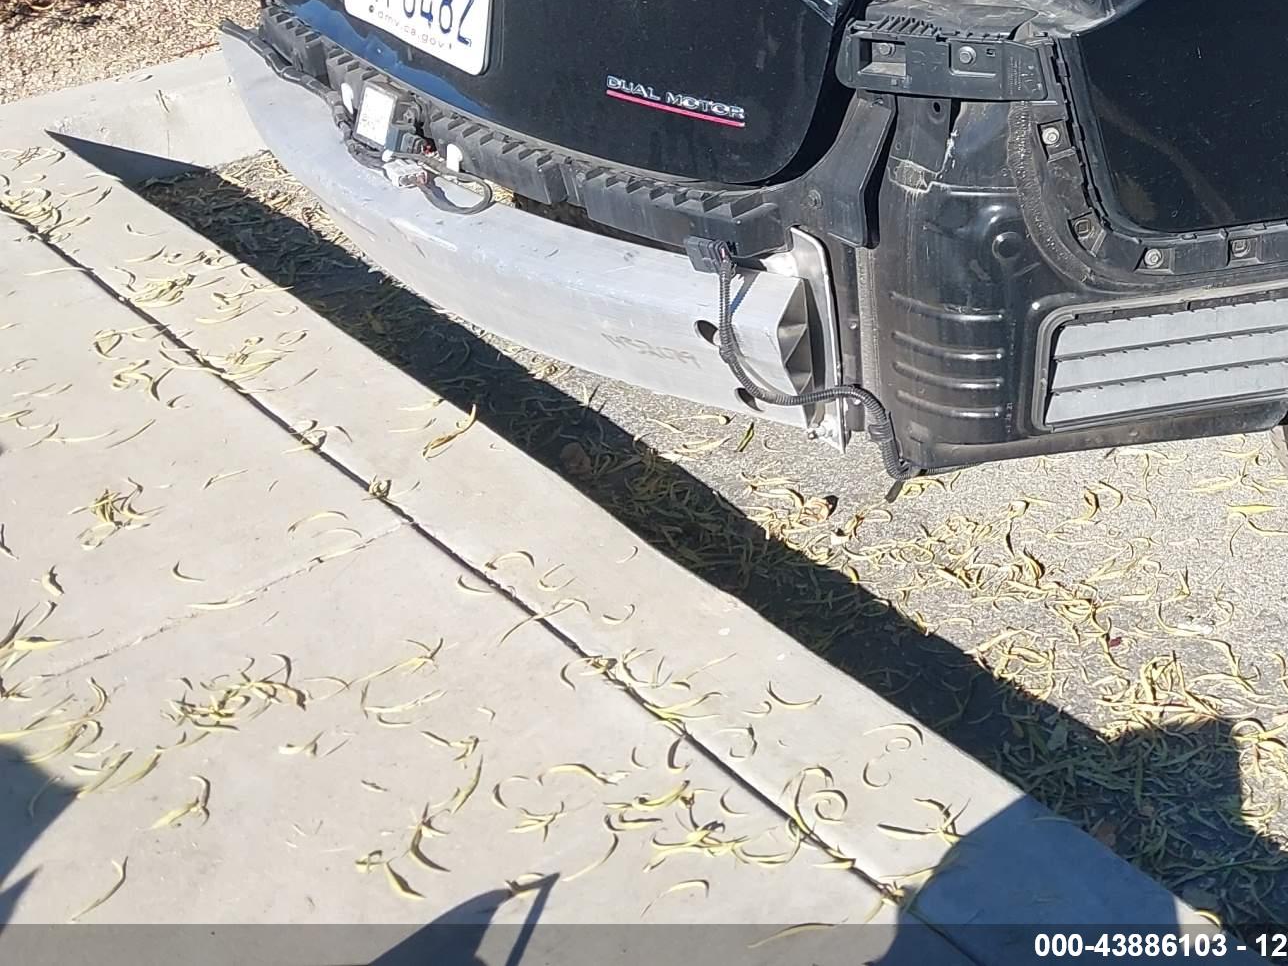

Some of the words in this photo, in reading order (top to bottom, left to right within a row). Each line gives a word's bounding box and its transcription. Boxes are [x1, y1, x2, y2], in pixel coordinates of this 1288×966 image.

[377, 11, 446, 49] dmv.ca.gov
[606, 76, 660, 100] DUAL
[667, 92, 745, 118] MOTOR
